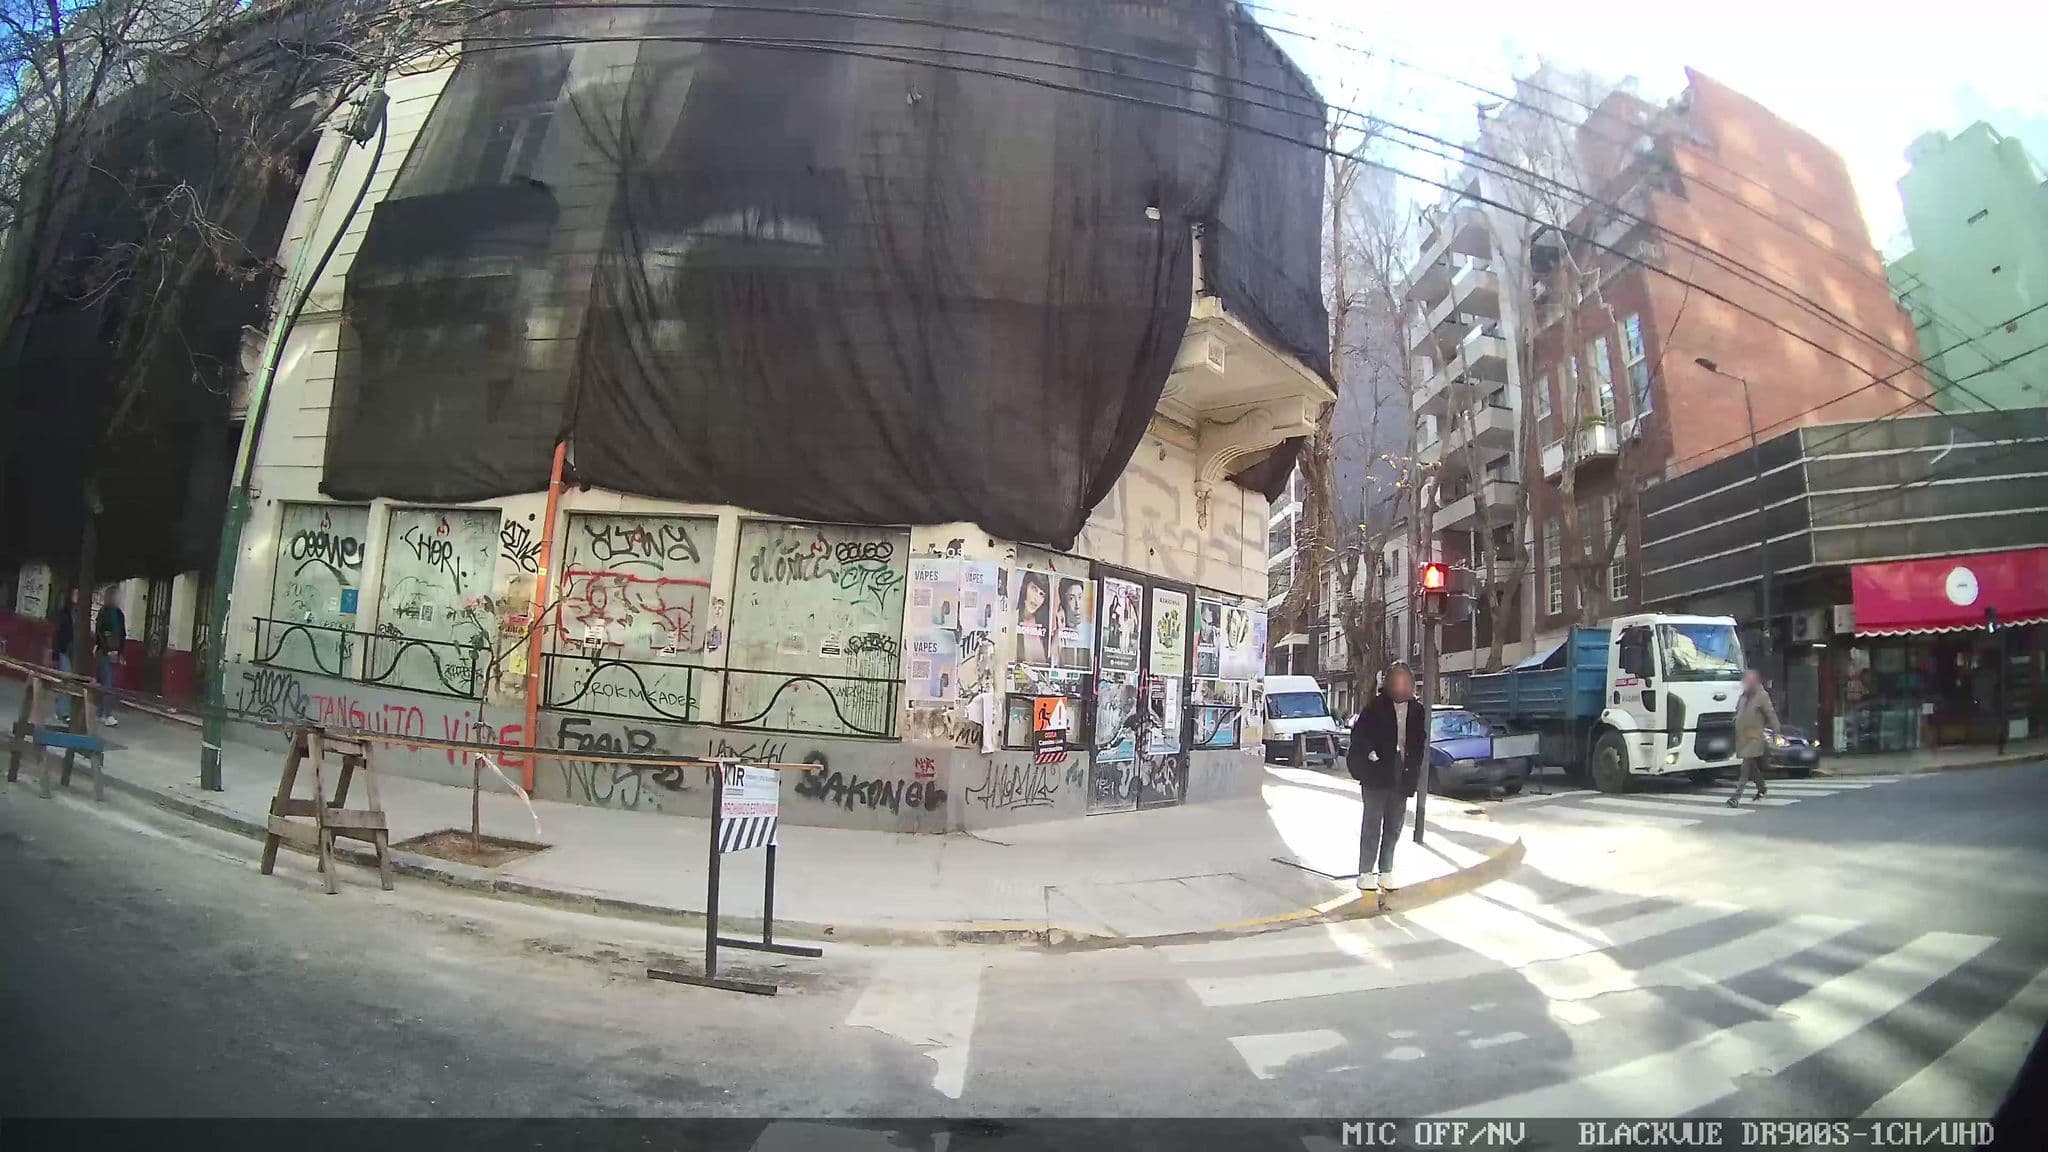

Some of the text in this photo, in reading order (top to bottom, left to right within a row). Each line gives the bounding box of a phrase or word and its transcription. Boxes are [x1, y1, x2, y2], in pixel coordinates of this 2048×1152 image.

[914, 570, 939, 581] VAPES
[965, 572, 984, 584] VAPES
[913, 641, 938, 653] VAPES
